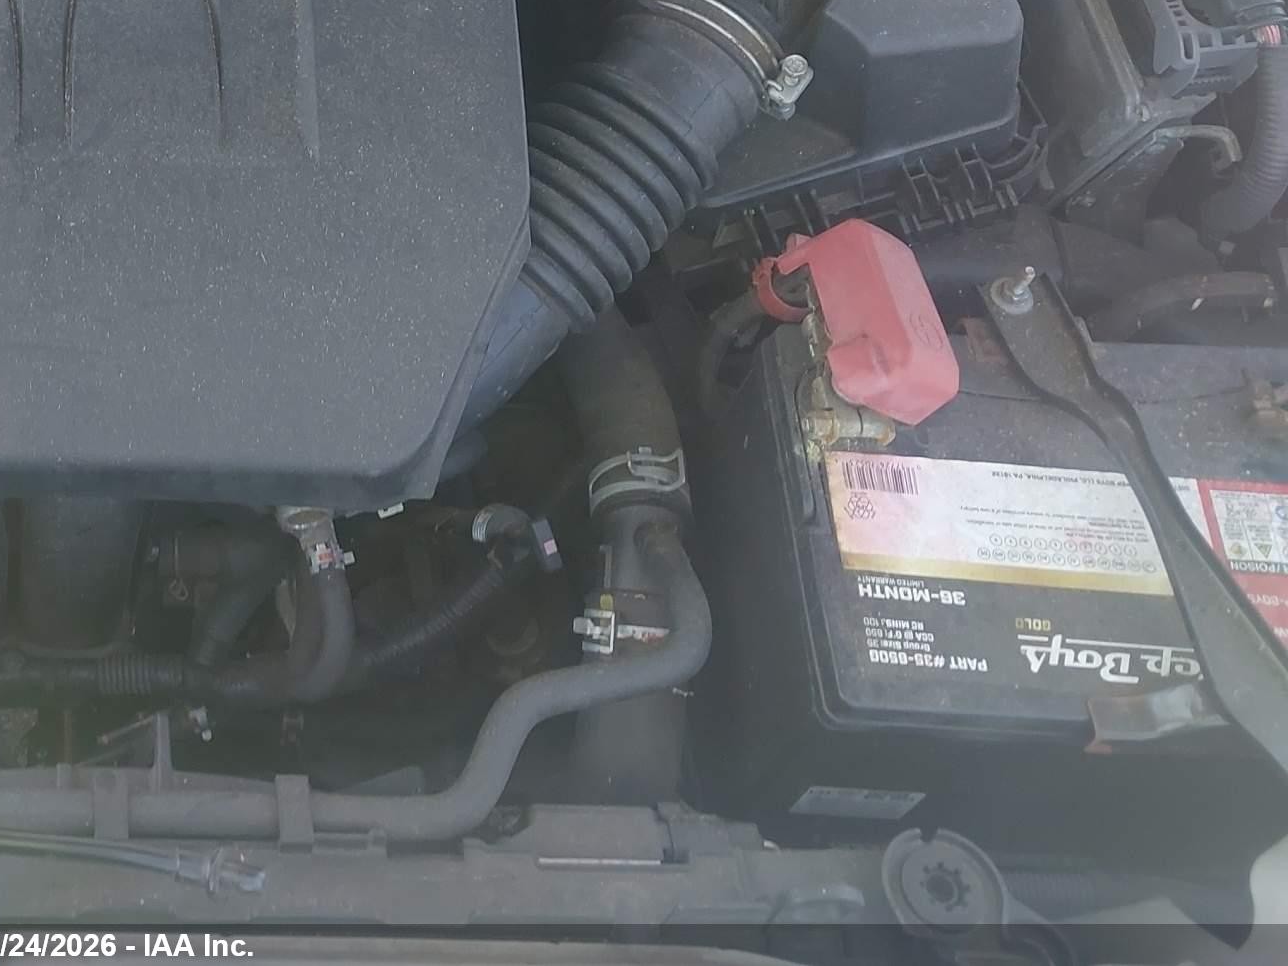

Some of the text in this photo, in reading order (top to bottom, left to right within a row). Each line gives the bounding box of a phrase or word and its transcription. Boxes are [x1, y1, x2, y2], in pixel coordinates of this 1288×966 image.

[857, 575, 924, 588] LIMITED WARRANTY
[858, 583, 966, 606] 36-MONTH
[1015, 617, 1051, 632] GOLD
[915, 631, 934, 642] CCA
[903, 641, 931, 652] Group
[949, 655, 988, 672] PART
[1020, 634, 1139, 684] Boys
